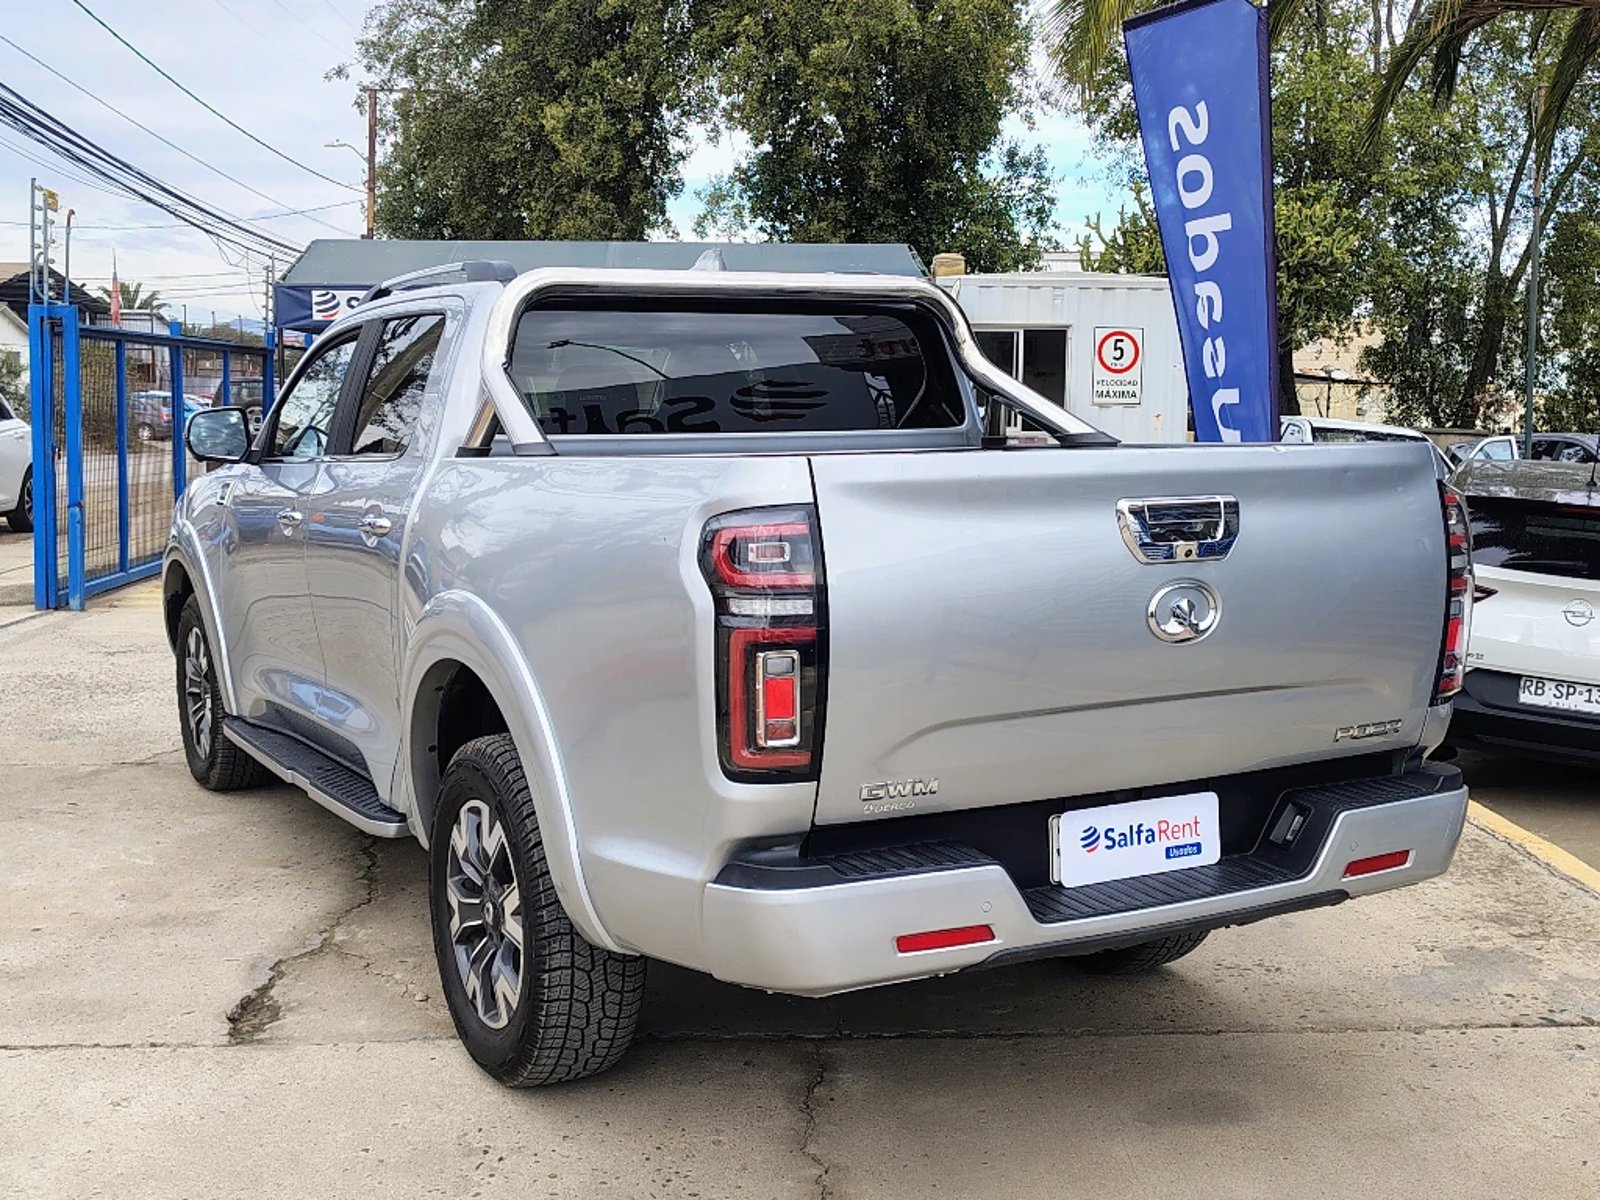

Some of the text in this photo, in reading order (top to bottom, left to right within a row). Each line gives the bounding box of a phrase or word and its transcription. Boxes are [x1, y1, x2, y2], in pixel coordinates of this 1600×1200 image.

[1112, 338, 1125, 361] 5
[1095, 387, 1138, 399] MÁXIMA
[860, 778, 939, 802] GWM
[1104, 815, 1201, 850] SalfaRent
